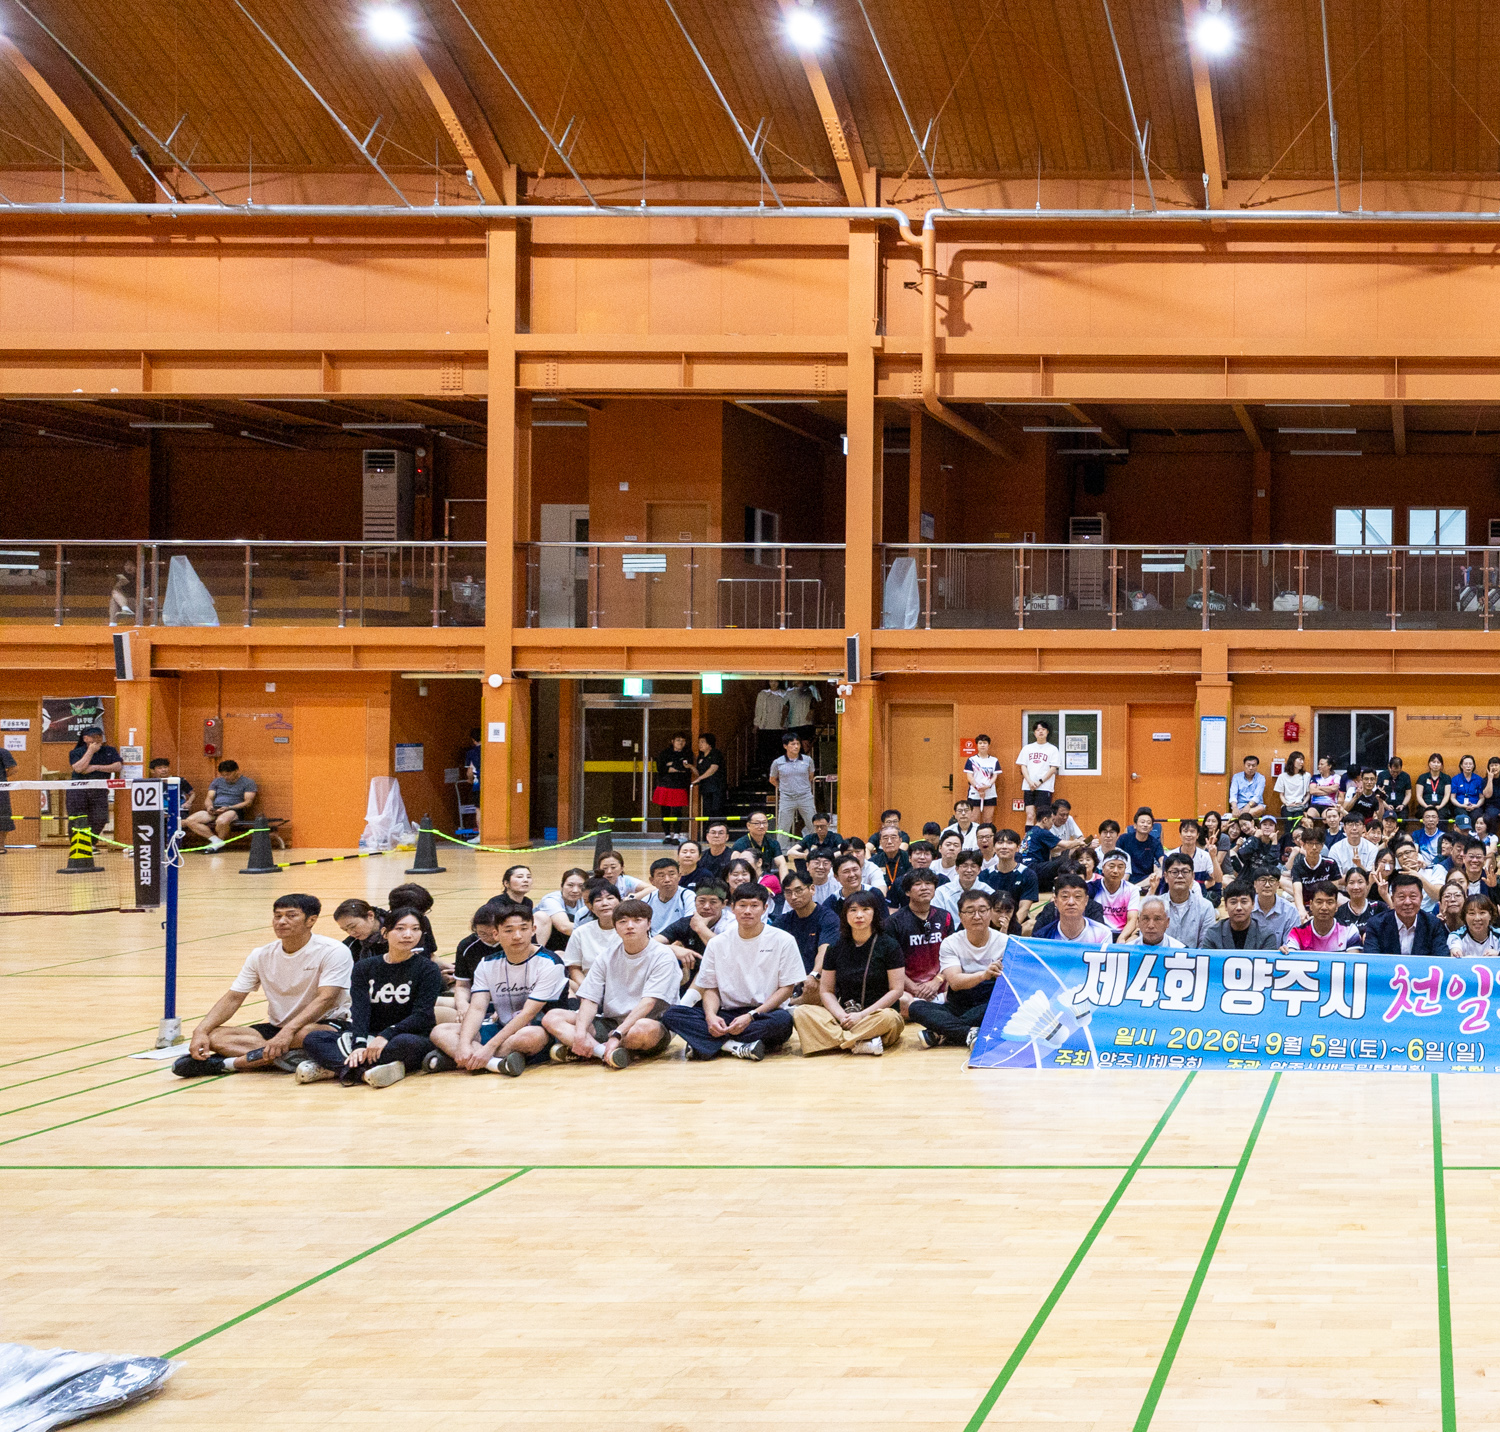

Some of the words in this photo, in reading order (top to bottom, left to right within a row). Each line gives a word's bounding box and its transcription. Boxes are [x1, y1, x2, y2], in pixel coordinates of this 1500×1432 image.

[134, 787, 157, 807] 02
[139, 844, 152, 887] RYDER
[368, 979, 411, 1004] Lee
[1073, 950, 1210, 1013] 제4회
[1219, 955, 1369, 1020] 양주시
[1113, 1027, 1156, 1047] 일시
[1166, 1027, 1260, 1053] 2026년
[1264, 1032, 1303, 1056] 9월
[1054, 1049, 1092, 1067] 주최
[1097, 1051, 1203, 1069] 양주시체육회
